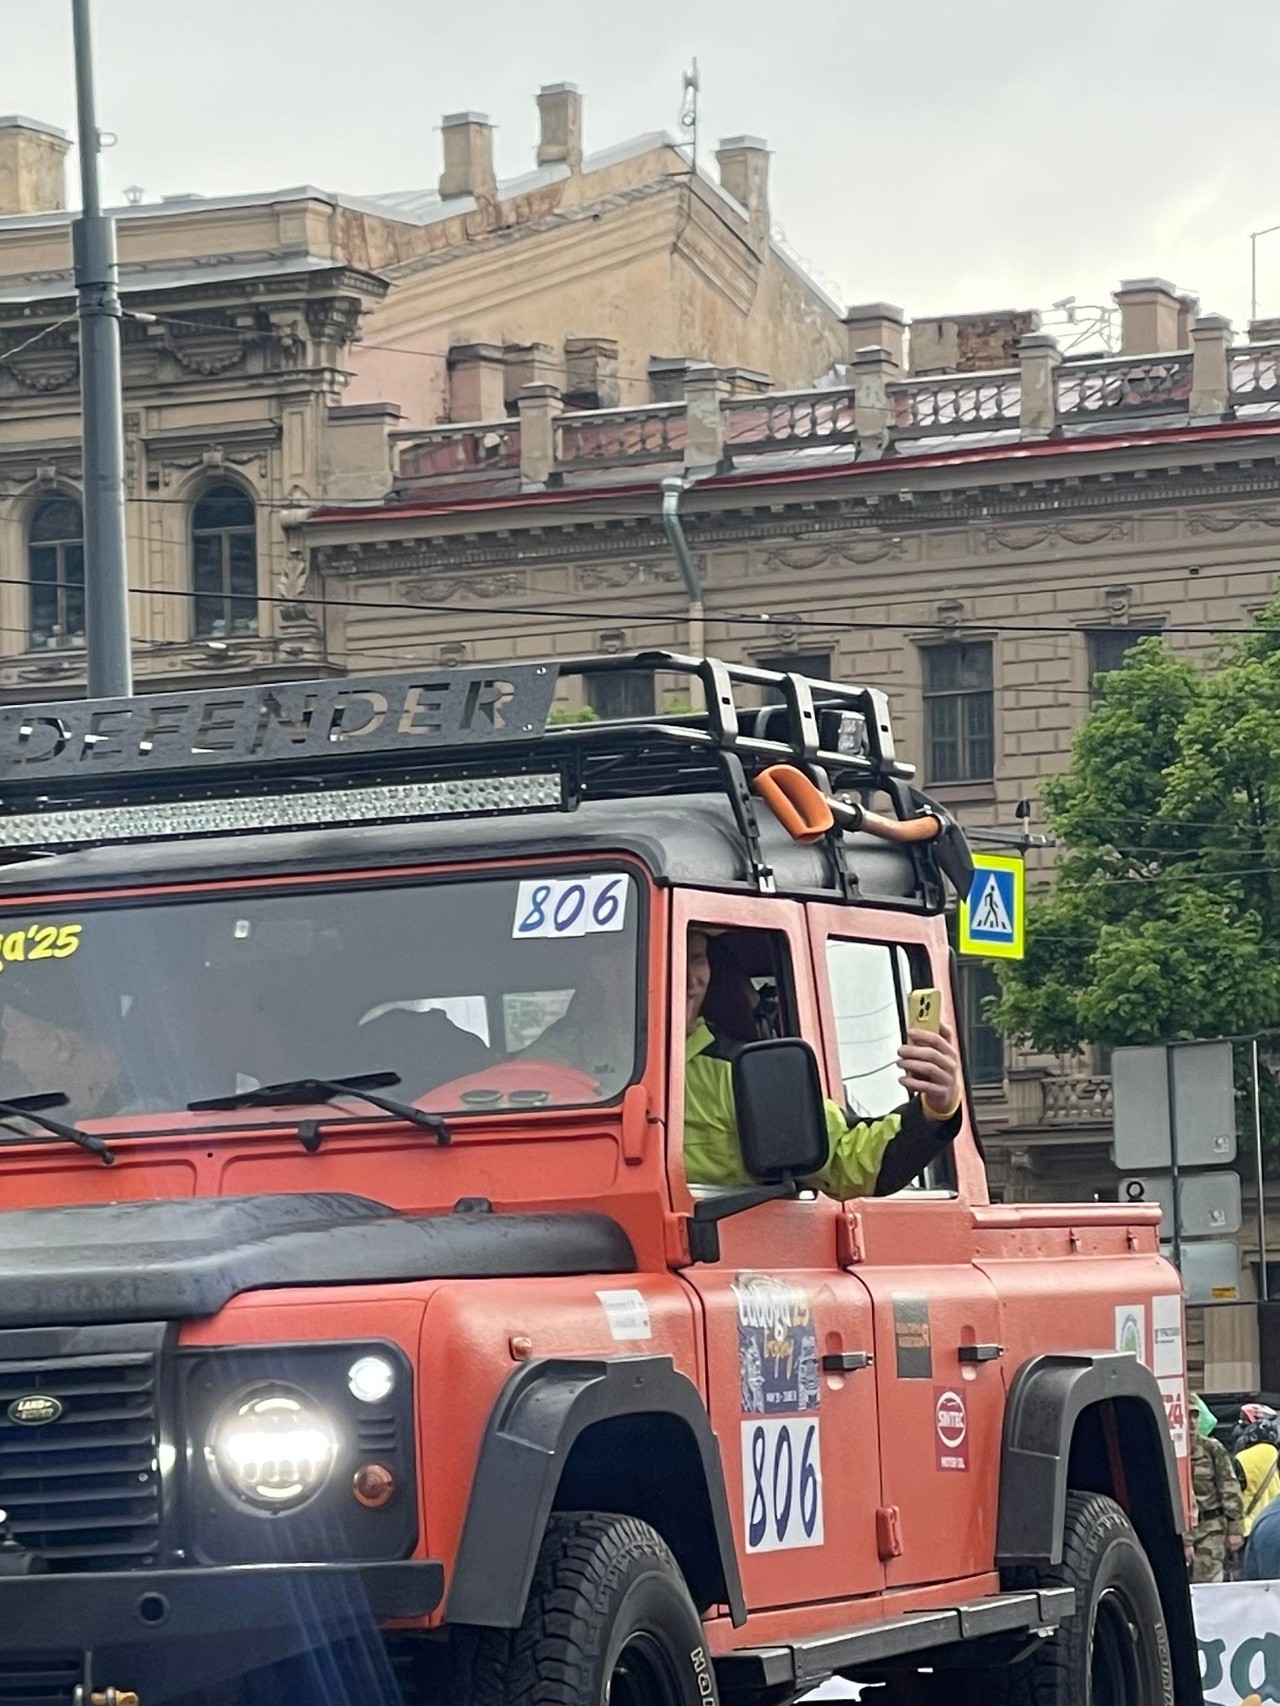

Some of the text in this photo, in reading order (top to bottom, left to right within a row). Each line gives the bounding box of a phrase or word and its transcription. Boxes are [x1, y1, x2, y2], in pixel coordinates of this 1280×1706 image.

[11, 679, 516, 764] DEFENDER
[518, 879, 622, 932] 806
[749, 1424, 818, 1548] 806
